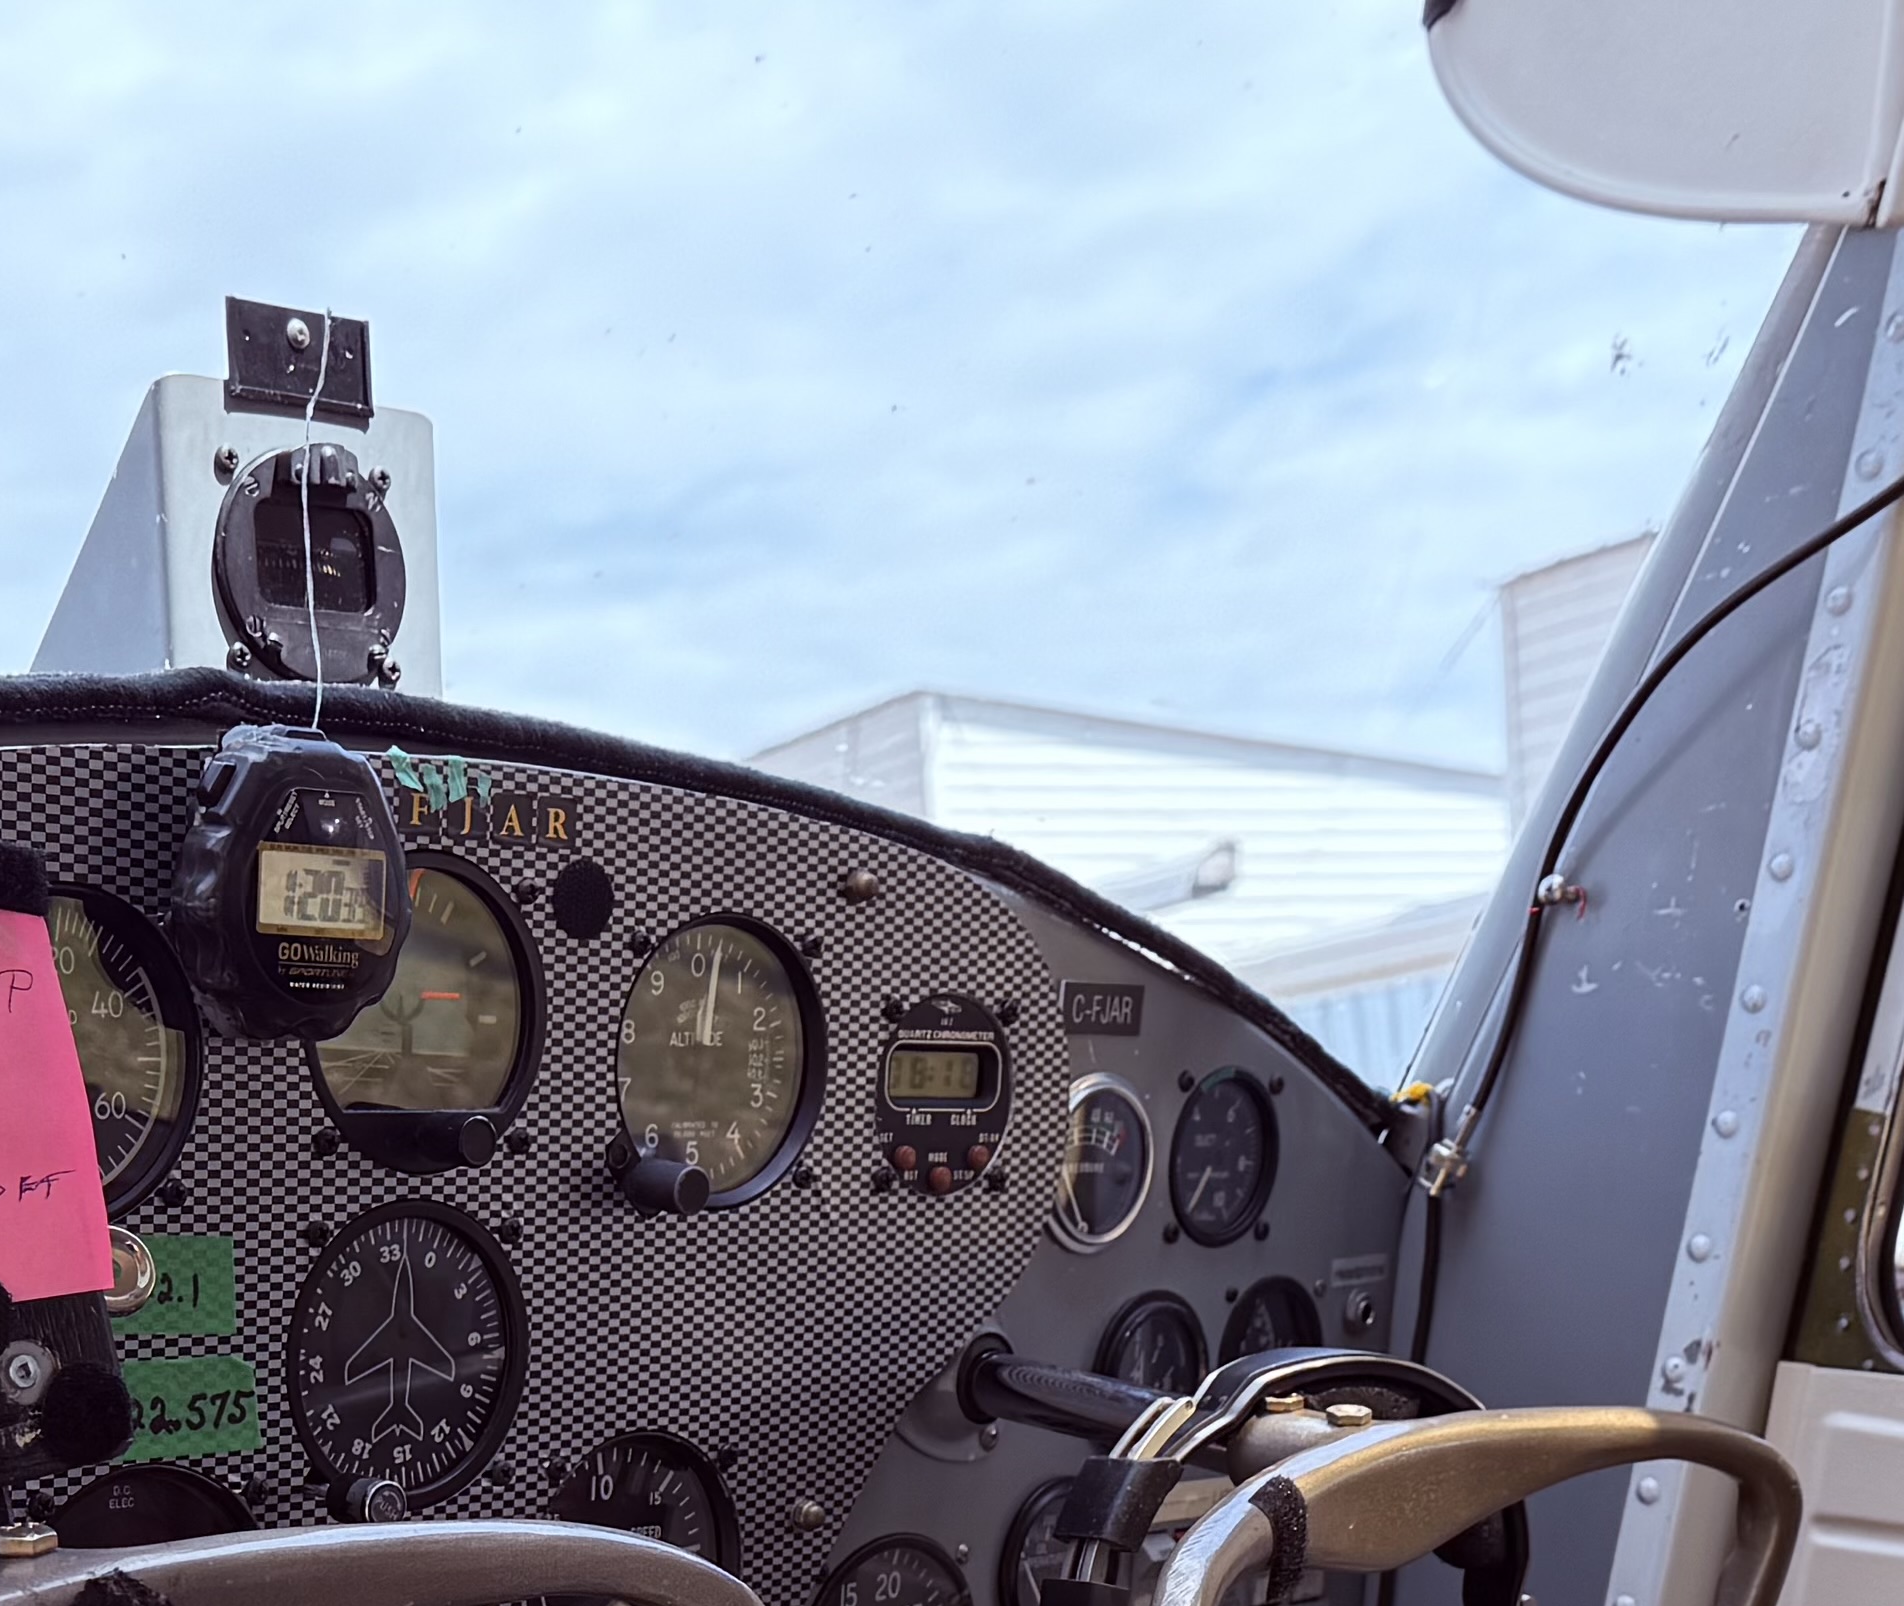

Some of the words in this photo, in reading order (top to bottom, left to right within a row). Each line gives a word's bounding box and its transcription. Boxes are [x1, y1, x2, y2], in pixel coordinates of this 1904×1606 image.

[92, 991, 124, 1019] 40
[1072, 994, 1133, 1026] C-FJAR
[93, 1092, 127, 1120] 60
[379, 1244, 402, 1263] 33
[339, 1261, 363, 1286] 30
[314, 1303, 334, 1331] 27
[309, 1355, 324, 1384] 24
[320, 1404, 341, 1431] 21
[431, 1417, 452, 1443] 12
[591, 1475, 614, 1501] 10
[109, 1497, 134, 1510] ELEC
[876, 1571, 901, 1602] 20
